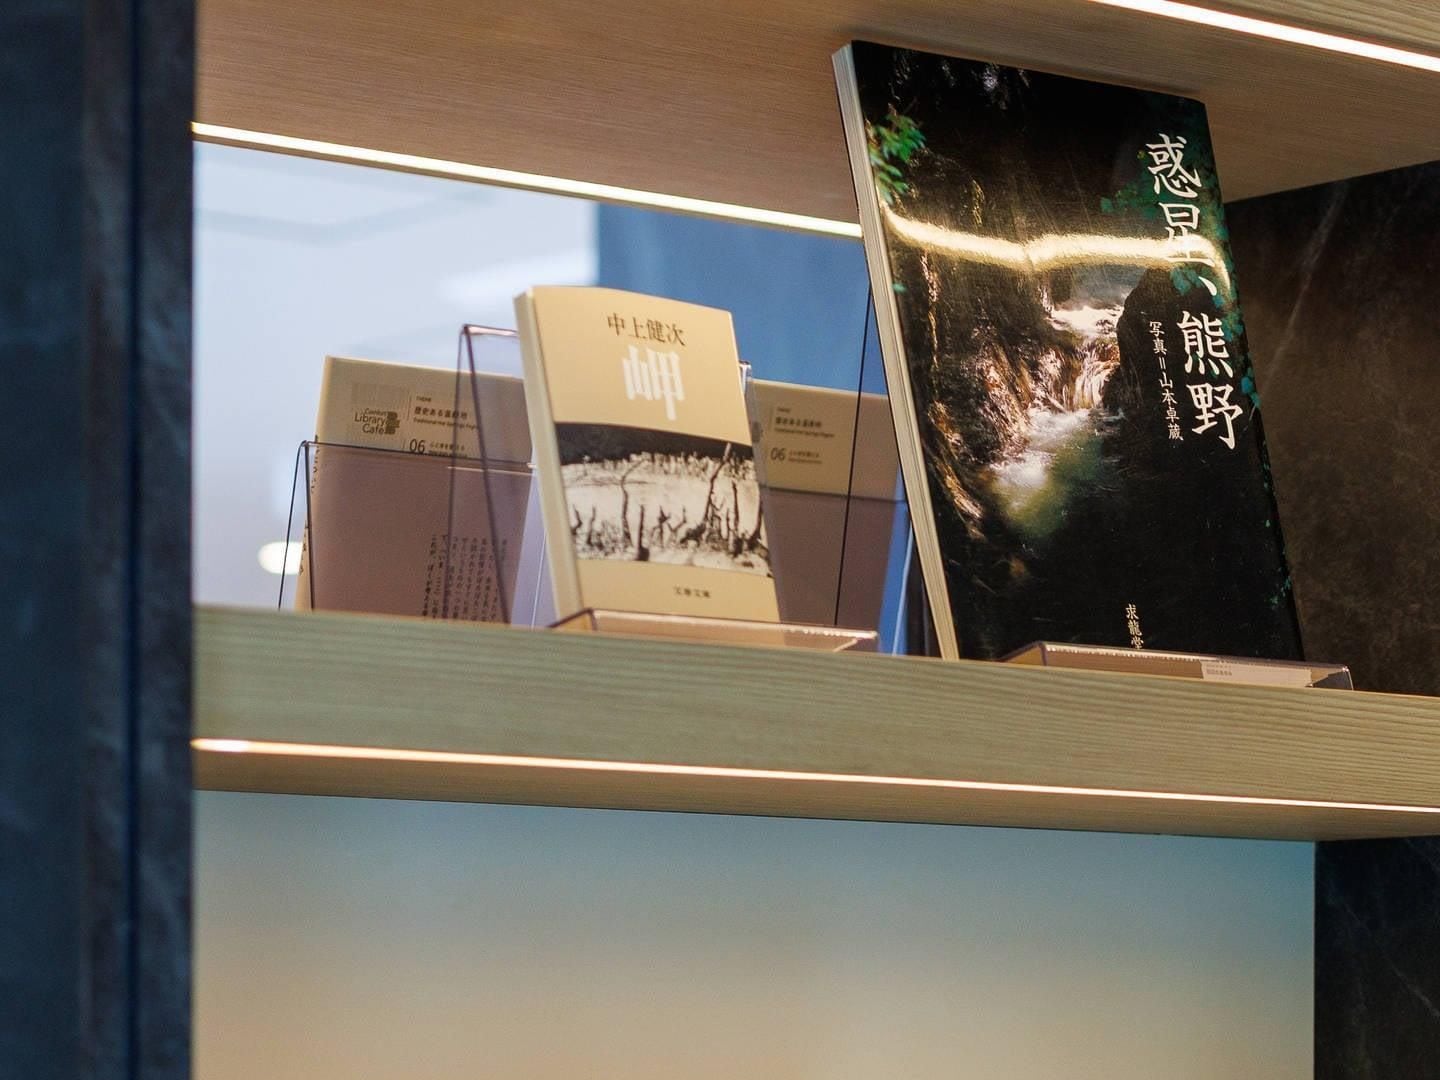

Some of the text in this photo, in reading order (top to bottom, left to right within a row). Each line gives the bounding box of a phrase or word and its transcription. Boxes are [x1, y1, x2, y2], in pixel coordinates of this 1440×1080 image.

[1146, 133, 1243, 449] 惑星、熊野
[606, 313, 686, 346] 中上健次
[622, 344, 686, 421] 岬
[354, 412, 386, 426] Library
[362, 422, 385, 435] Cafe
[409, 438, 426, 454] 06
[770, 447, 786, 462] 06
[1125, 603, 1144, 650] 求龍堂
